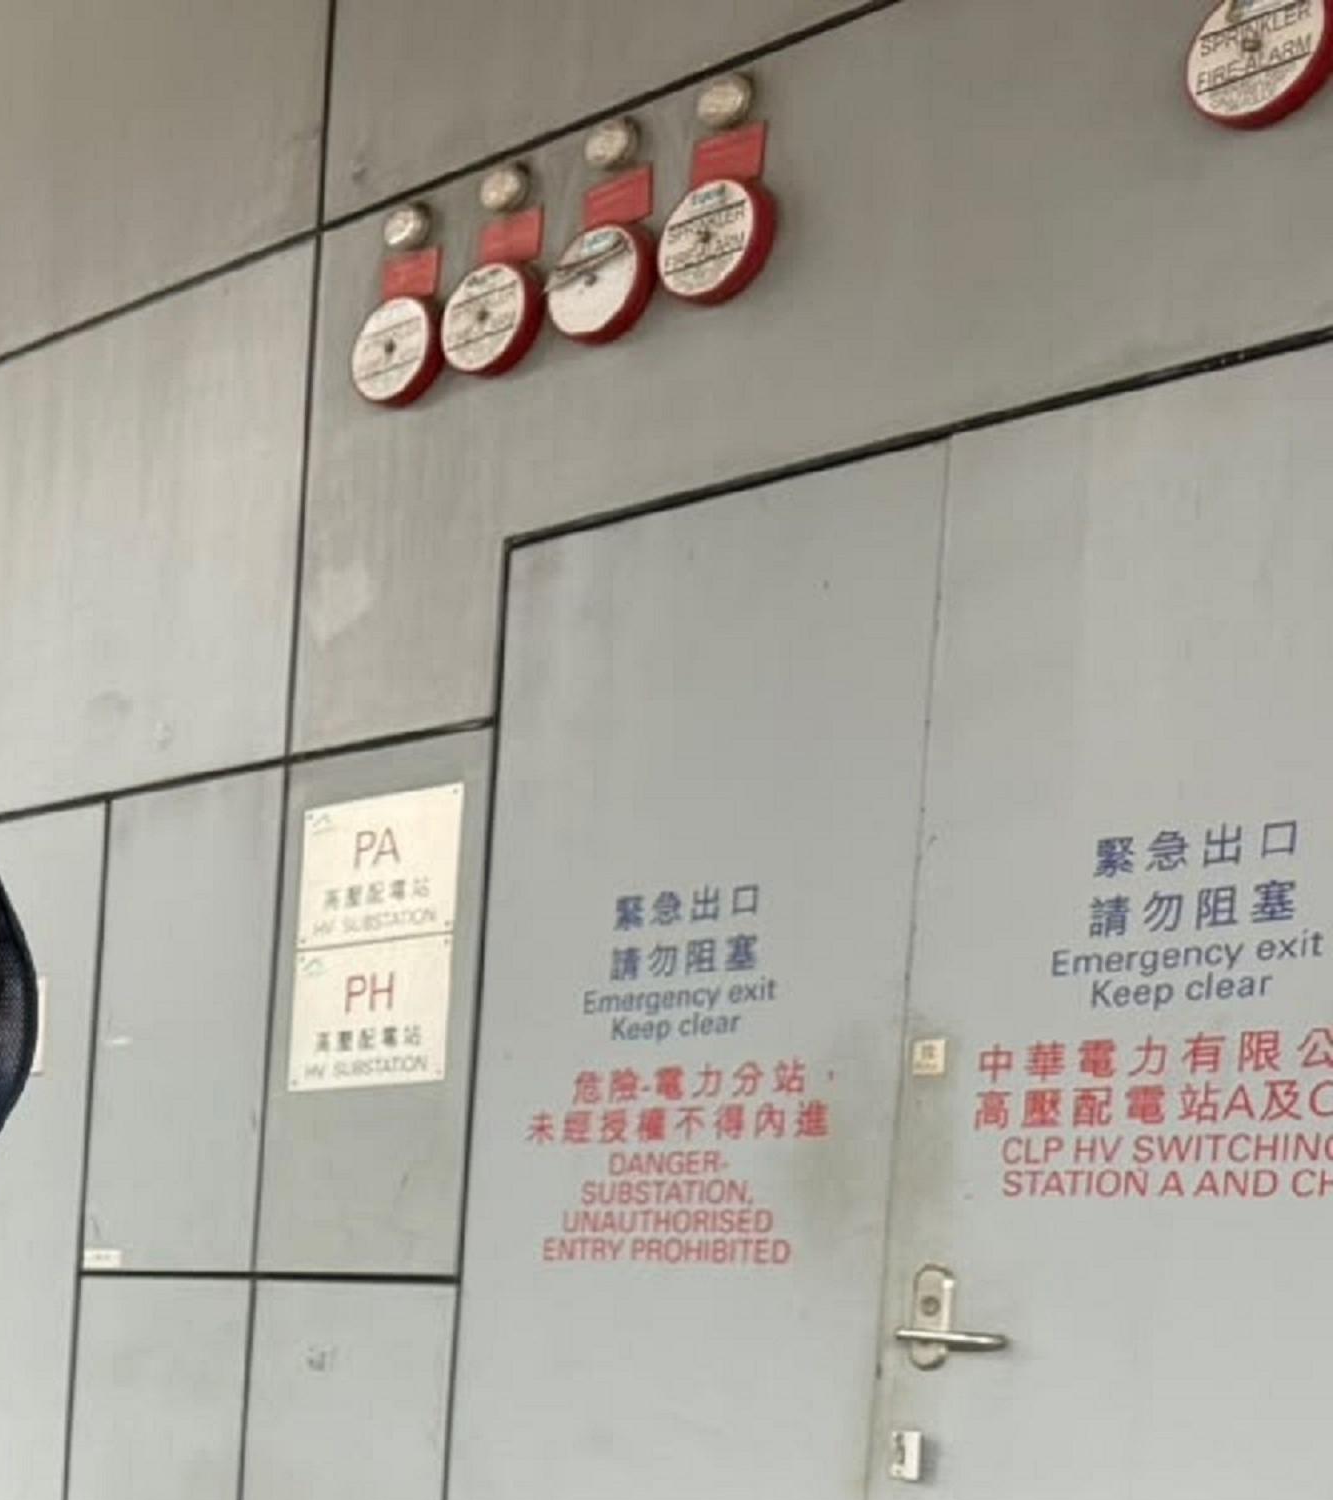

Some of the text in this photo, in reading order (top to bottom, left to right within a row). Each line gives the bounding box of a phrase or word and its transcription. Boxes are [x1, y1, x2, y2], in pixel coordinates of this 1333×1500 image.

[1197, 59, 1243, 92] FIRE
[1244, 33, 1313, 74] ALARM
[353, 826, 402, 870] PA
[1093, 818, 1297, 880] 緊急出口
[613, 882, 760, 933] 緊急出口
[1087, 878, 1297, 941] 請勿阻塞
[609, 932, 758, 982] 請勿阻塞
[1050, 927, 1325, 979] Emergency exit
[343, 970, 396, 1016] PH
[583, 975, 778, 1017] Emergency exit
[1090, 970, 1274, 1013] Keep clear
[610, 1010, 743, 1047] Keep clear
[977, 1027, 1333, 1083] 中華電力有限公
[1002, 1136, 1064, 1166] CLP
[1073, 1134, 1124, 1164] HV
[1001, 1168, 1149, 1198] STATION
[1158, 1169, 1186, 1198] A
[1192, 1168, 1279, 1198] AND
[562, 1207, 774, 1235] UNAUTHORISED
[541, 1236, 792, 1265] ENTRY PROHIBITED
